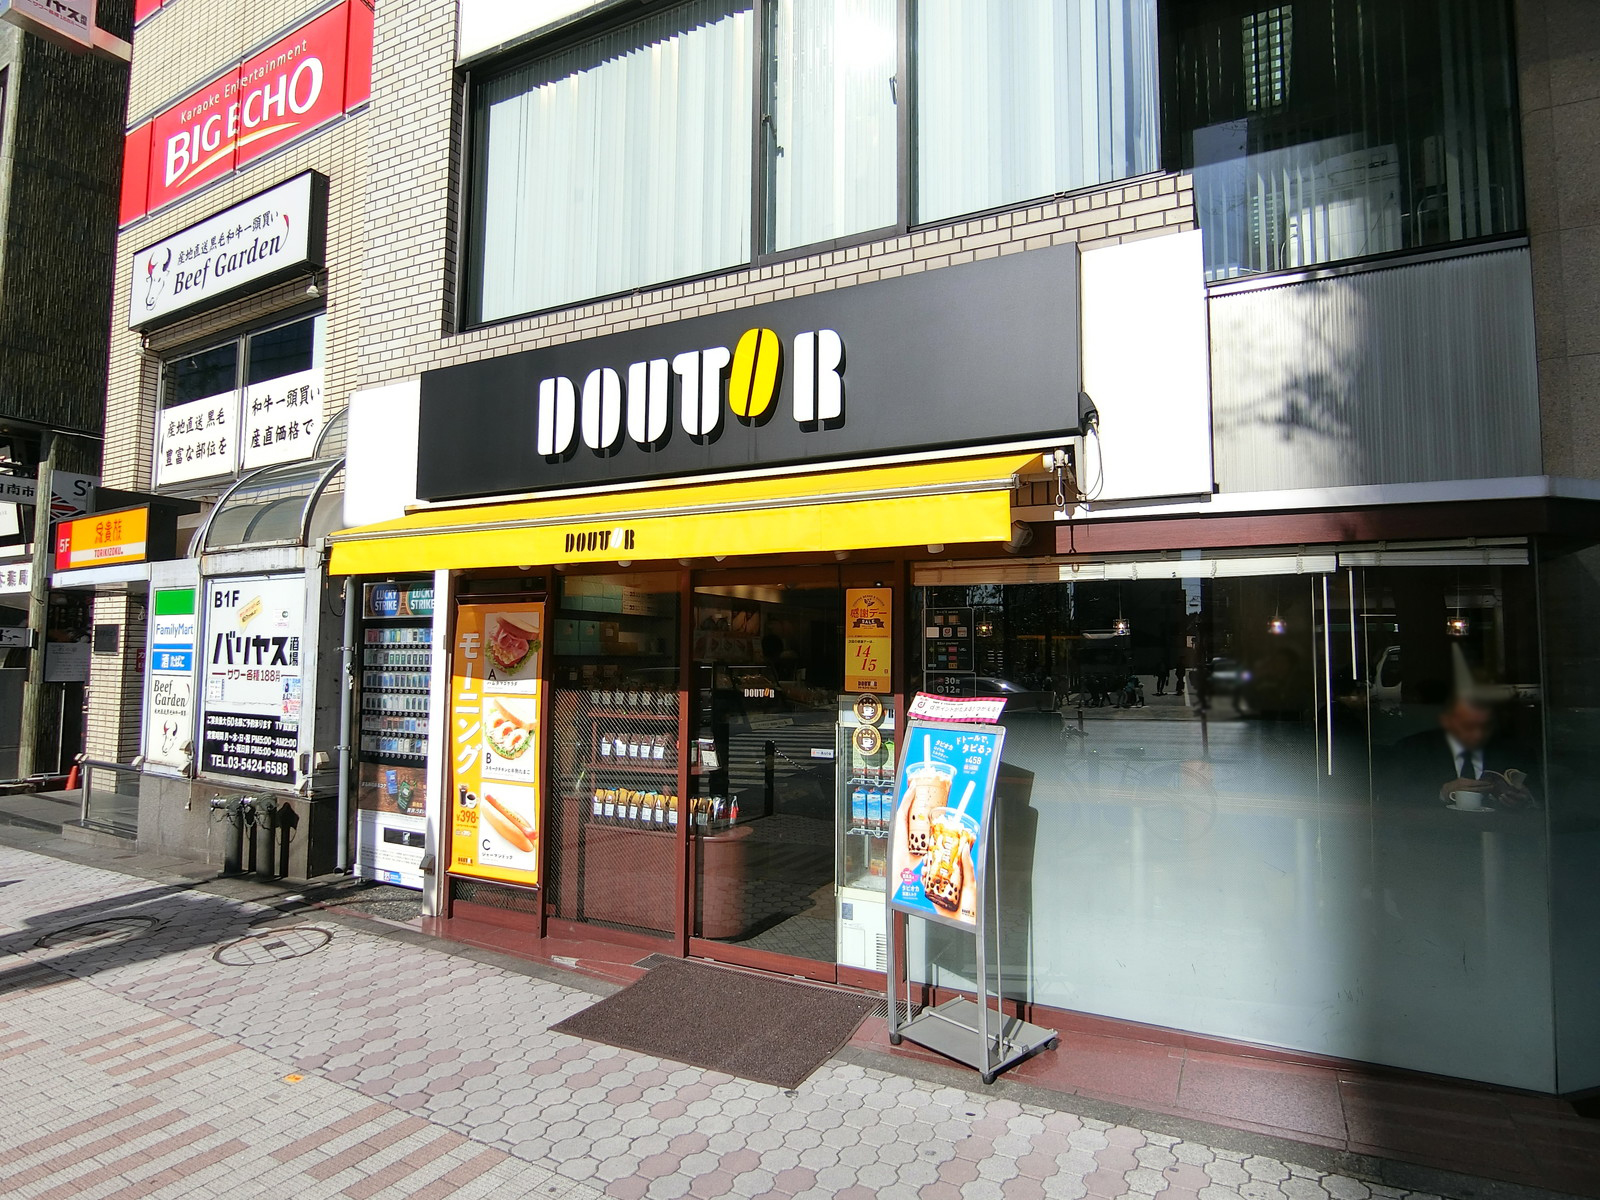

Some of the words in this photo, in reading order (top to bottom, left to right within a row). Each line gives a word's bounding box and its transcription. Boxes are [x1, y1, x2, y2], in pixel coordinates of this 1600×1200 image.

[181, 93, 219, 124] Karaoke
[224, 39, 307, 98] Entertainment
[165, 114, 221, 187] BIG
[227, 57, 324, 138] ECHO
[177, 210, 279, 266] 産地直送黒毛和牛一頭買い
[173, 257, 211, 295] Beef
[215, 235, 281, 278] Garden
[251, 384, 320, 416] 和牛一頭買い
[538, 328, 843, 456] DOUTOR
[167, 407, 225, 438] 産地直送黒毛
[250, 418, 314, 448] 産直価格で
[165, 437, 227, 467] 豊富な部位を
[60, 538, 70, 553] 5F
[565, 527, 635, 552] DOUTOR
[215, 590, 240, 608] B1F
[376, 589, 397, 600] LUCKY
[375, 600, 397, 611] STRIKE
[850, 608, 887, 618] 感謝デー
[156, 623, 194, 638] FamilyMart
[856, 645, 871, 657] 14
[861, 658, 877, 671] 15
[488, 669, 496, 680] A
[154, 680, 172, 695] Beef
[744, 688, 775, 698] DOUTOR
[155, 693, 186, 708] Garden
[456, 633, 482, 775] モーニング
[211, 754, 288, 776] TEL.03-5424-6588
[486, 753, 492, 764] B
[482, 839, 491, 851] C
